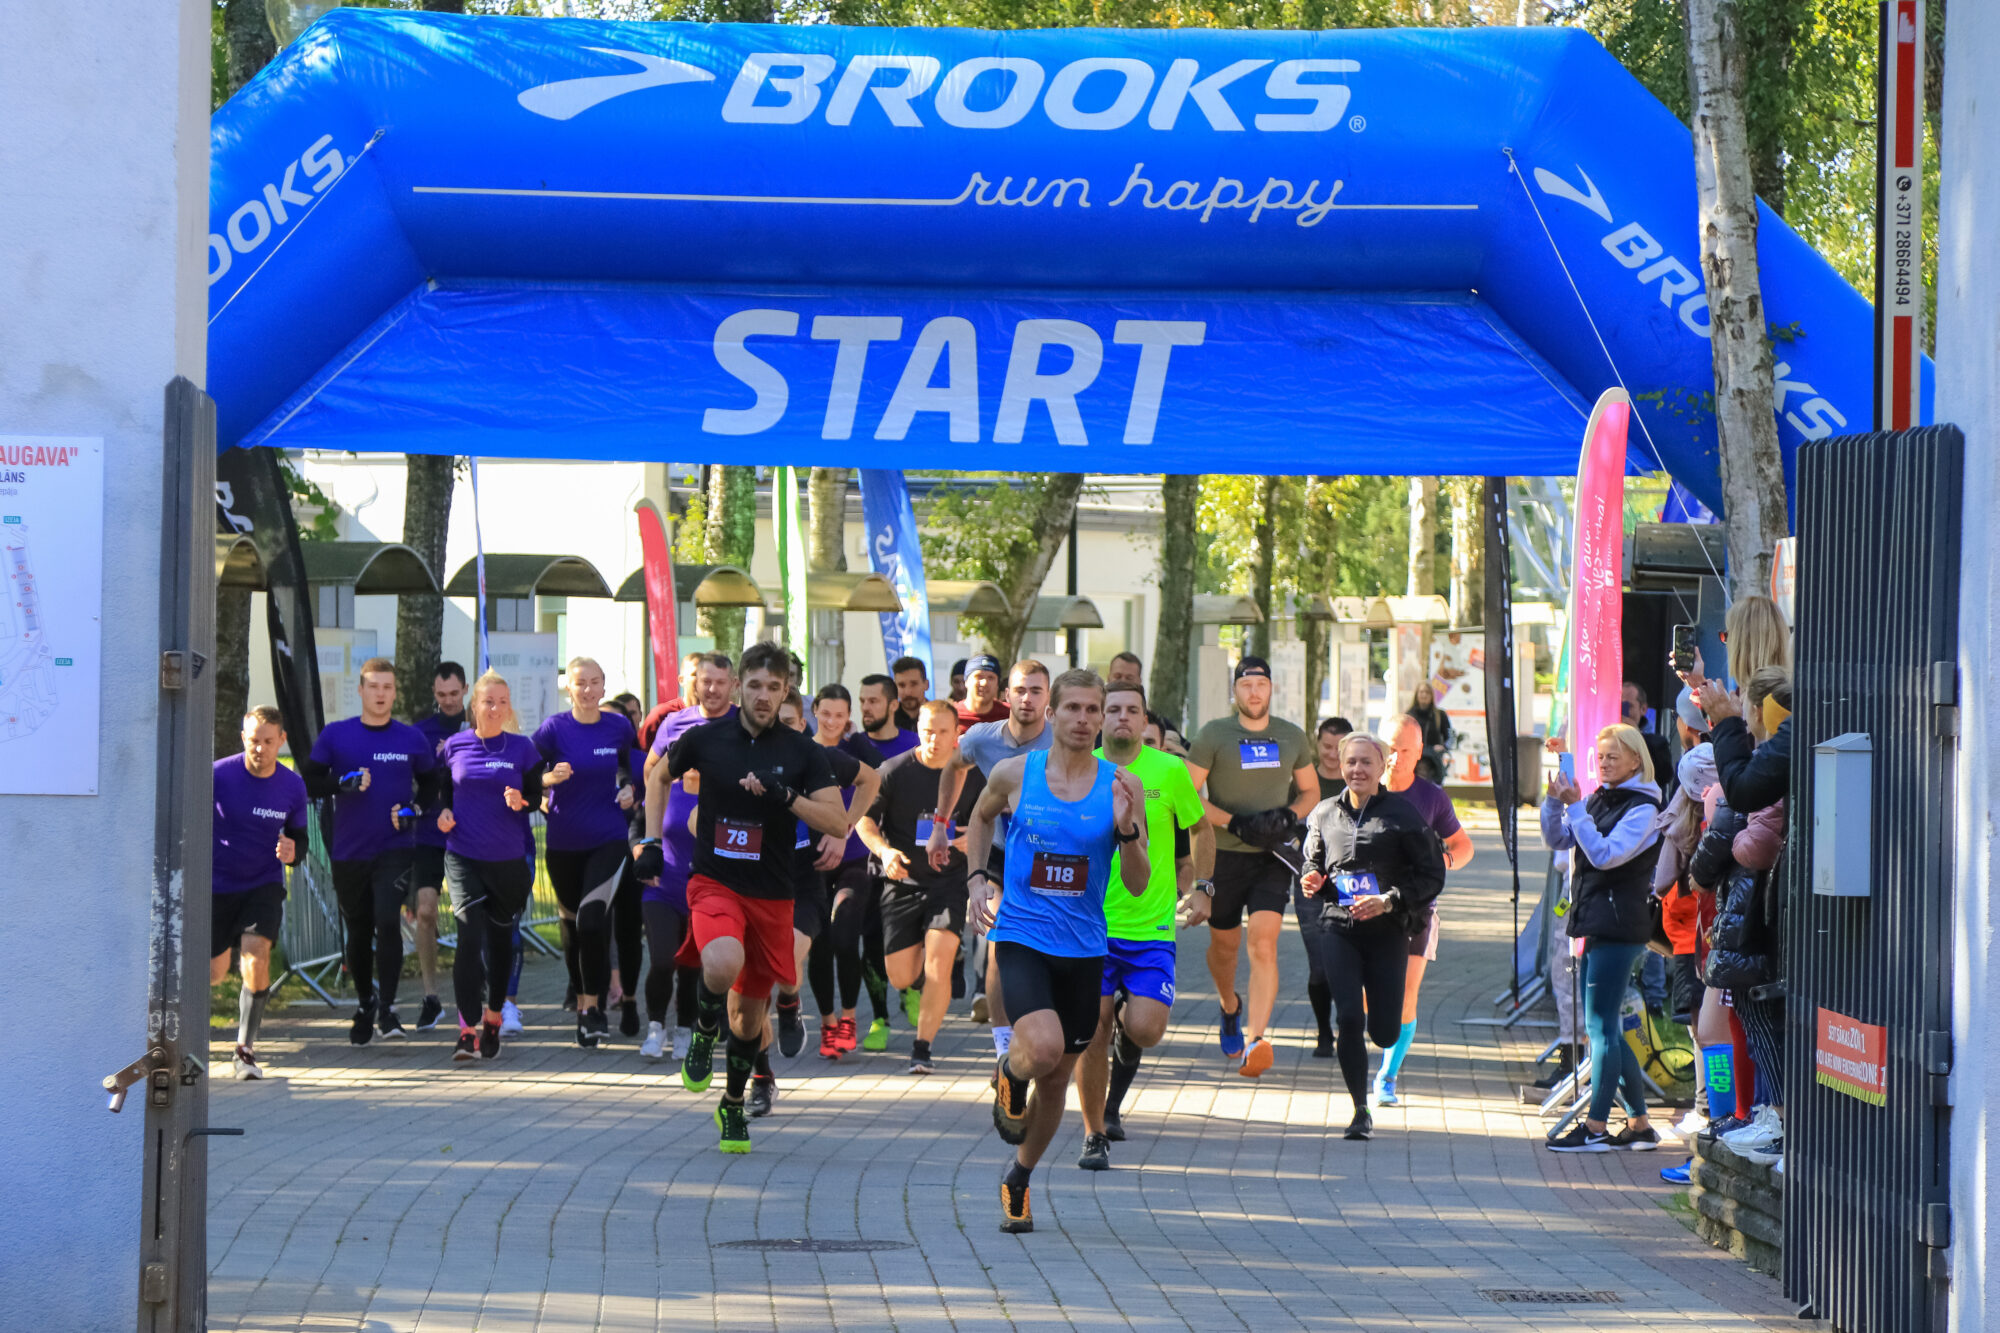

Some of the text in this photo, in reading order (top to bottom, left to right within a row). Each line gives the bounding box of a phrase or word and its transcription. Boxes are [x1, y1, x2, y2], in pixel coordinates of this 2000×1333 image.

[722, 53, 1361, 132] BROOKS
[953, 163, 1344, 227] run happy
[1895, 194, 1912, 306] +371 28664494
[701, 309, 1207, 447] START
[1251, 746, 1268, 757] 12
[727, 829, 748, 845] 78
[1045, 866, 1074, 883] 118
[1342, 876, 1370, 893] 104
